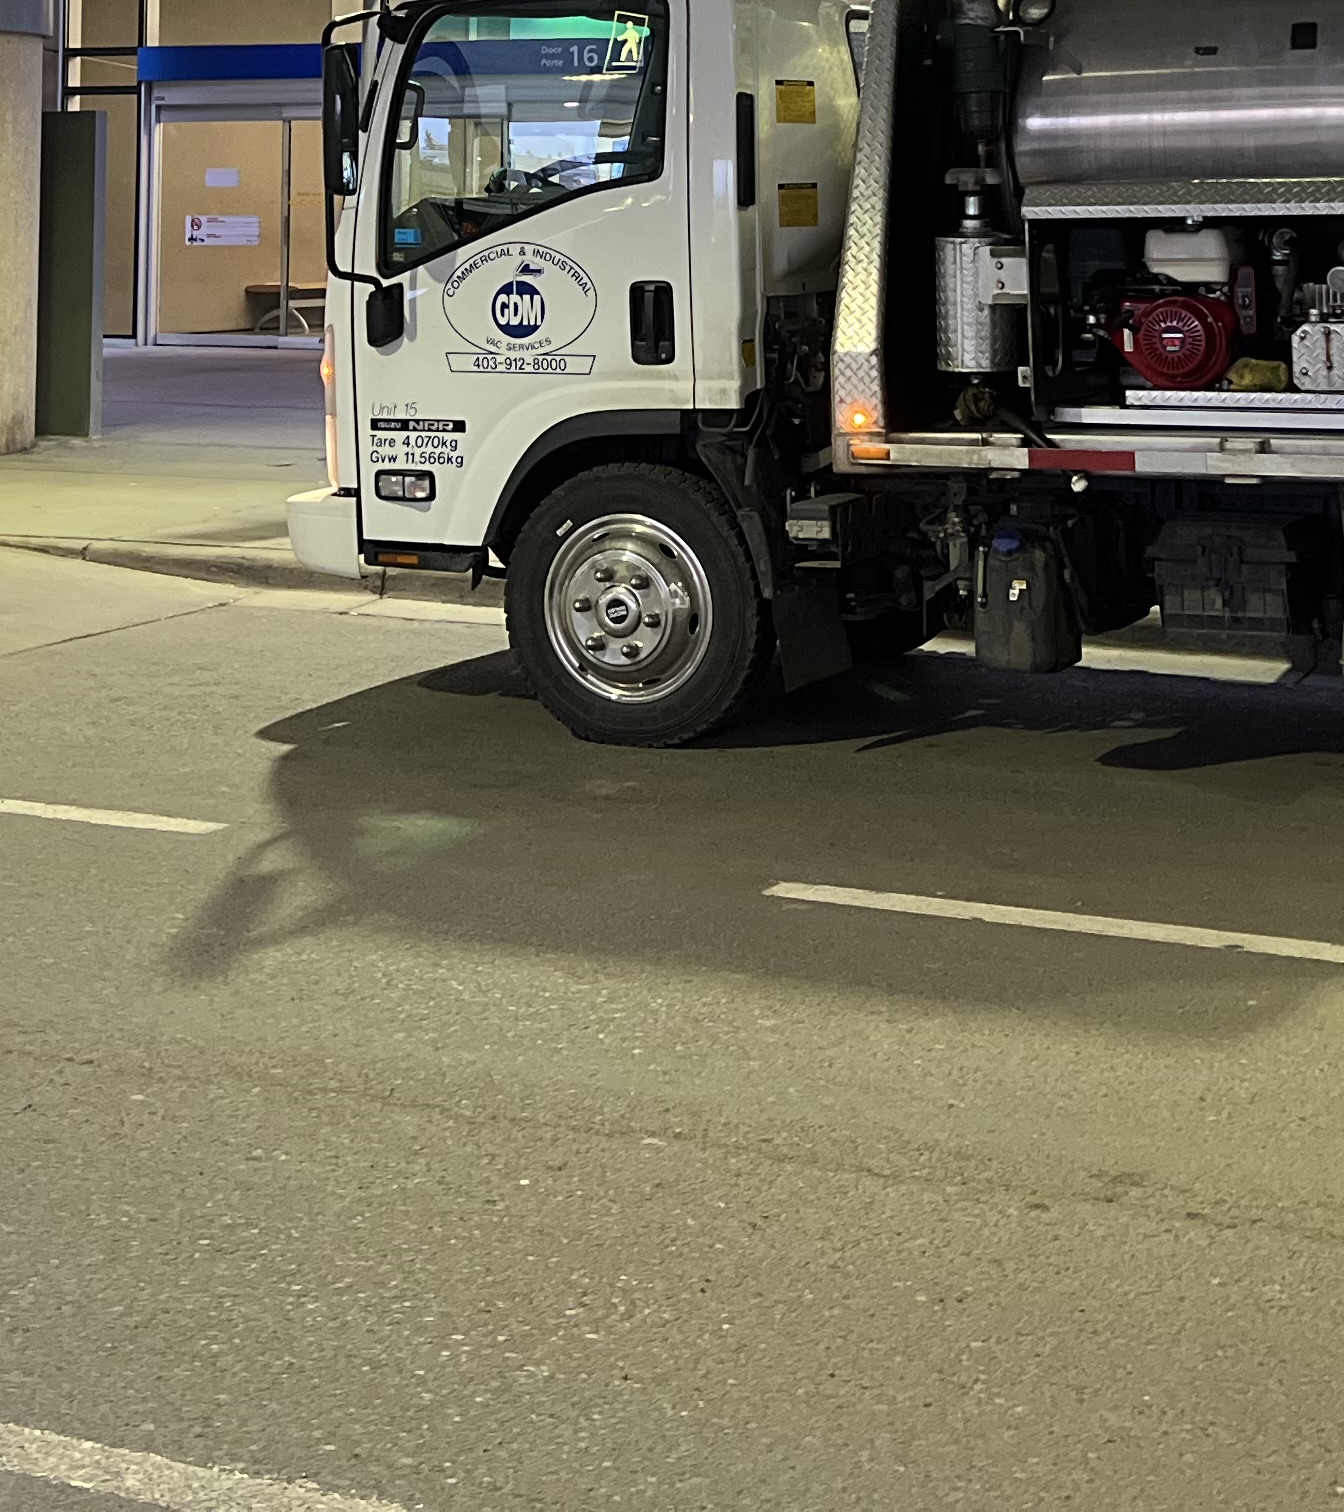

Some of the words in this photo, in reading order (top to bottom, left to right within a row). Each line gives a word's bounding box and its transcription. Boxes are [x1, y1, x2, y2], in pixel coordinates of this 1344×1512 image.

[541, 45, 563, 55] Door
[569, 45, 598, 67] 16
[541, 58, 564, 67] Porte
[445, 247, 513, 298] COMMERCIAL
[518, 246, 526, 256] &
[532, 248, 592, 297] INDUSTRIAL
[485, 336, 503, 349] VAC
[506, 337, 552, 352] SERVICES
[473, 356, 567, 372] 403-912-8000
[371, 401, 397, 417] Unit
[404, 401, 418, 417] 15
[408, 420, 454, 431] NRR
[369, 434, 396, 448] Tare
[402, 435, 458, 452] 4,070kg
[369, 450, 398, 464] Gvw
[404, 451, 464, 468] 11,566kg
